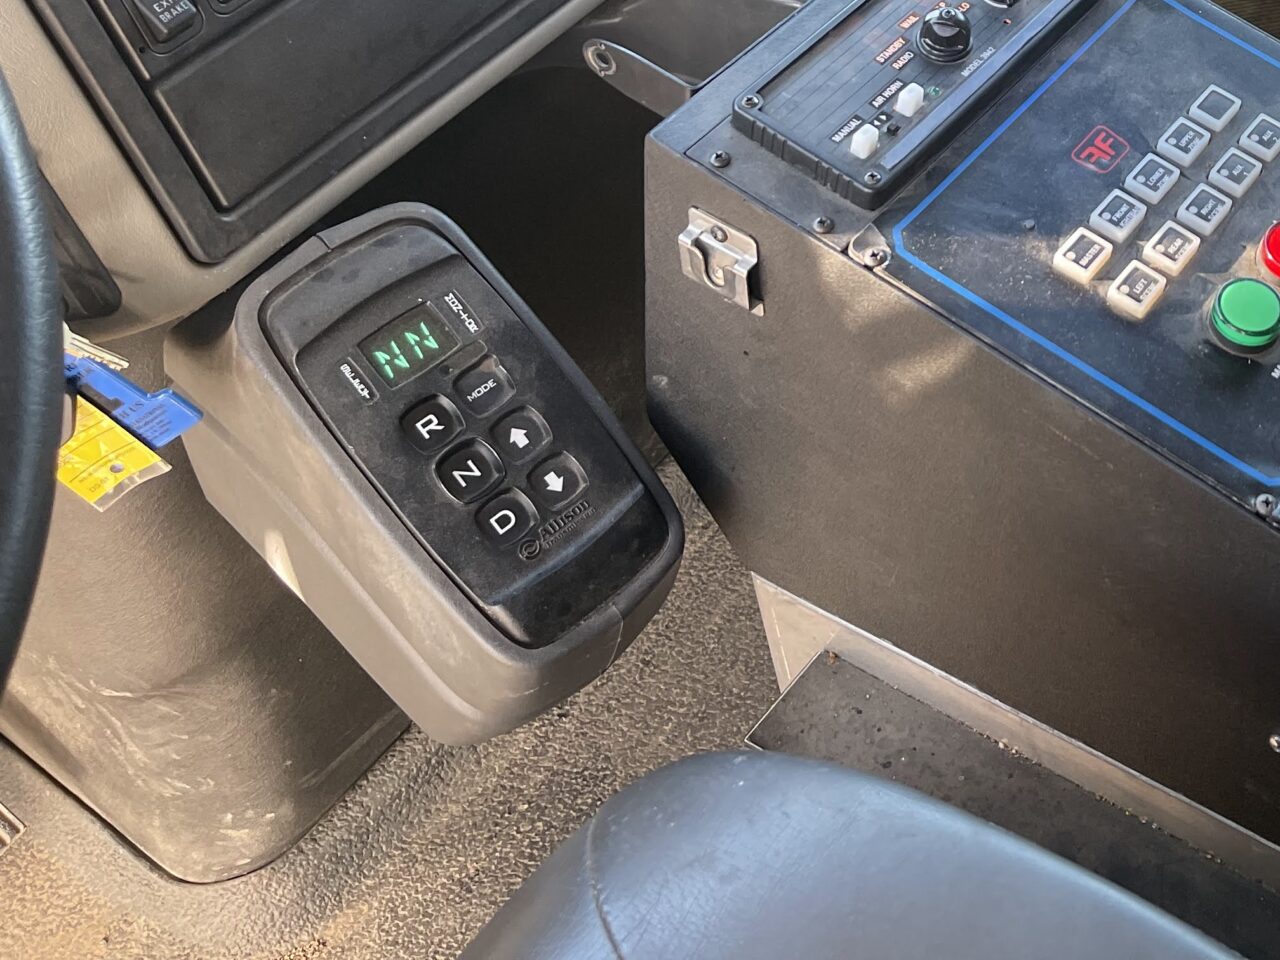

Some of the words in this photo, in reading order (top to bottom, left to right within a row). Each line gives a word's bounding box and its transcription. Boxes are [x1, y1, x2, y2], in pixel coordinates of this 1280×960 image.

[159, 2, 189, 23] BRAKE
[900, 15, 919, 29] WAIL
[876, 36, 906, 63] STANDBY
[892, 51, 914, 69] RADIO
[961, 58, 982, 77] MODEL
[871, 96, 886, 108] AIR
[882, 80, 903, 98] HORN
[831, 118, 862, 142] MANUAL
[1180, 131, 1194, 147] UPPER
[1262, 130, 1274, 141] AUX
[1147, 167, 1165, 186] LOWER
[1232, 165, 1243, 176] AUX
[1112, 203, 1130, 222] FRONT
[1078, 244, 1101, 266] MASTER
[1167, 238, 1184, 254] REAR
[1132, 278, 1148, 294] LEFT
[444, 293, 479, 333] MONITOR
[340, 363, 370, 399] SELECT
[467, 378, 497, 403] MODE
[415, 414, 445, 440] R
[452, 459, 482, 488] N
[489, 509, 516, 535] D
[538, 500, 590, 542] Allison
